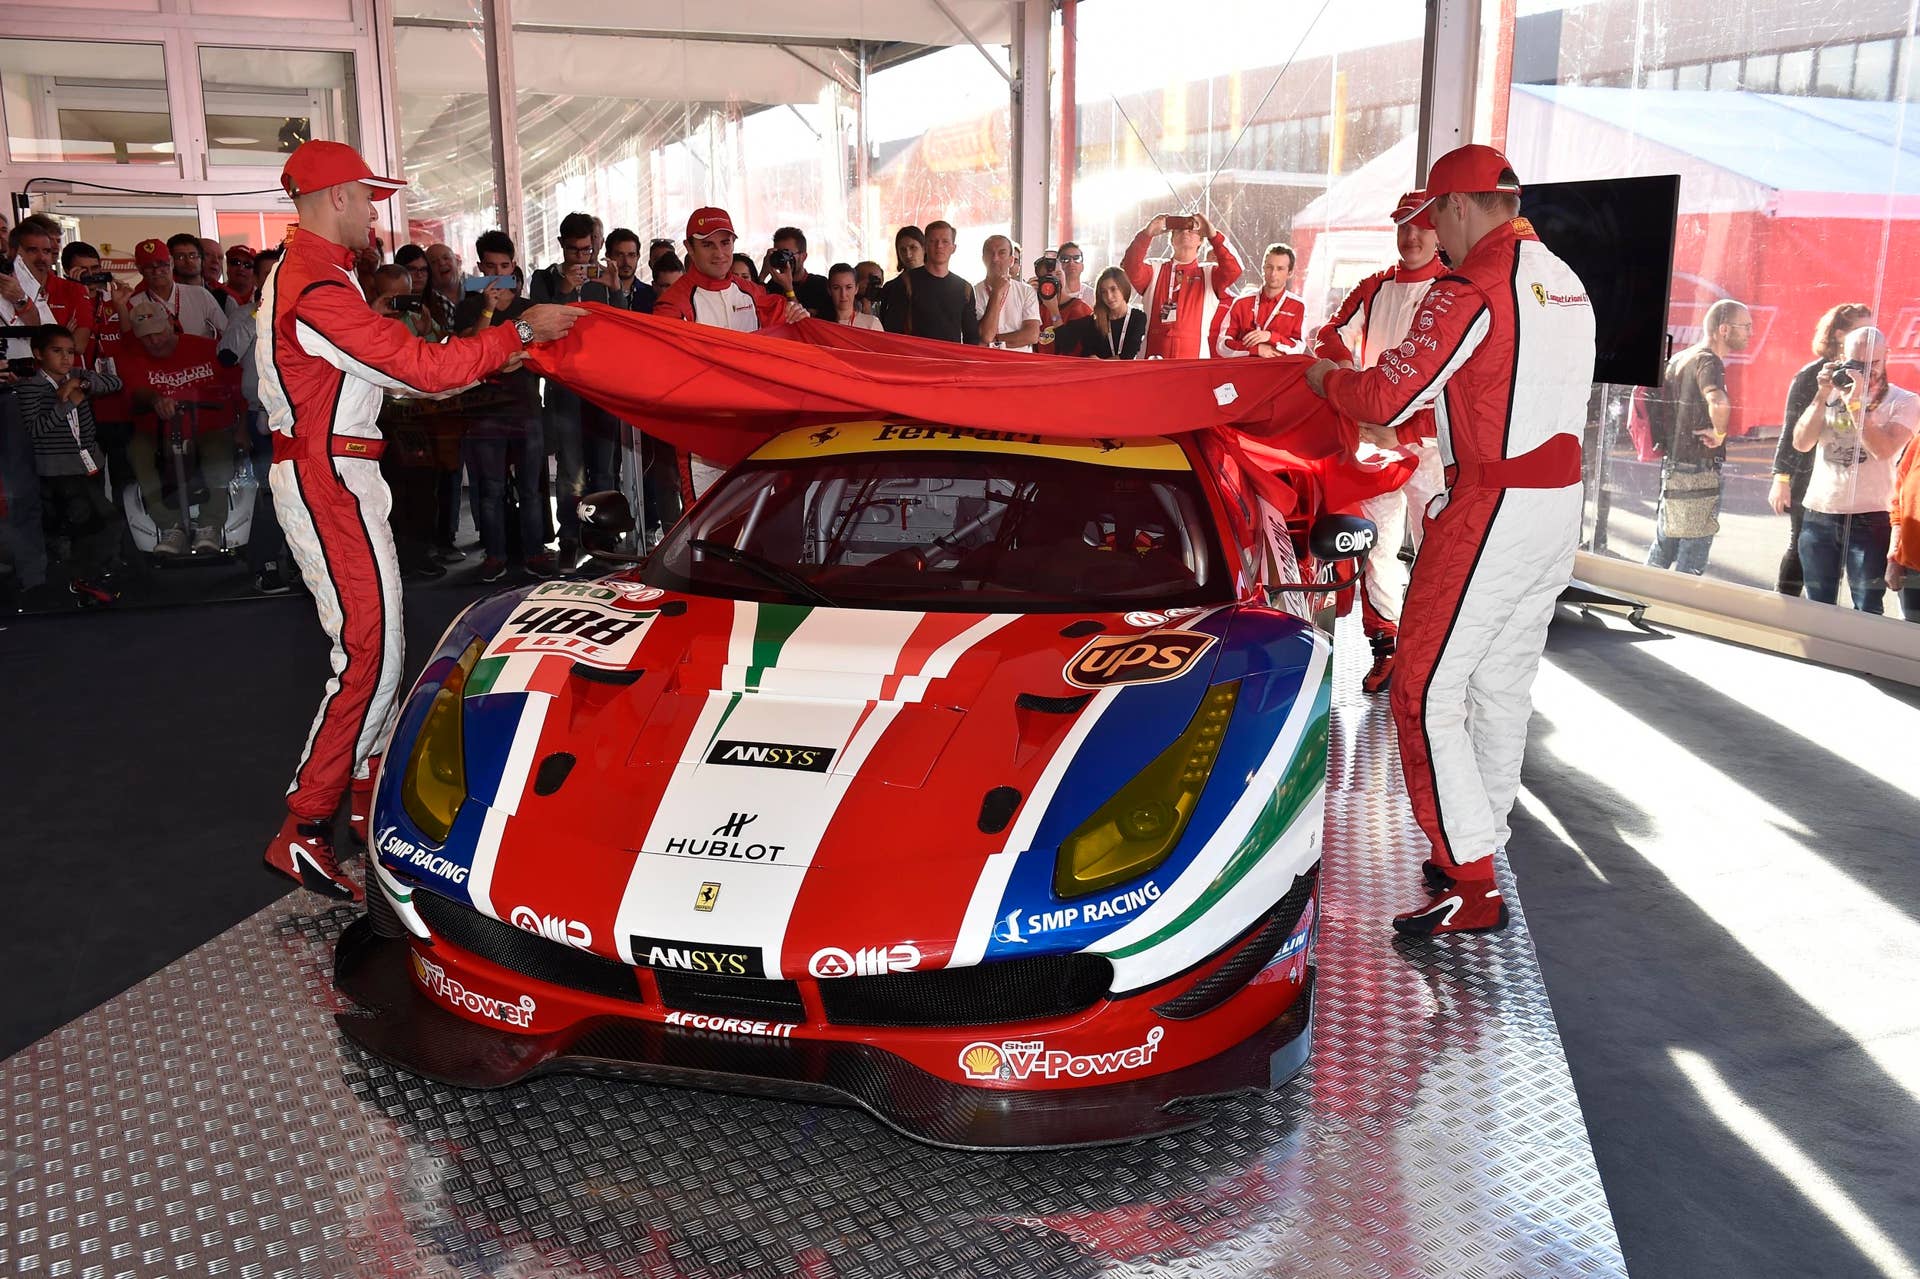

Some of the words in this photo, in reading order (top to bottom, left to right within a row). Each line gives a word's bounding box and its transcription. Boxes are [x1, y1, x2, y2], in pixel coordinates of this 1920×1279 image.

[1383, 351, 1417, 378] HUBLOT
[872, 424, 1042, 444] Ferrari
[536, 583, 617, 600] PRO
[508, 607, 644, 646] 488
[532, 636, 609, 658] GTE
[722, 745, 817, 766] ANSYS
[384, 836, 415, 860] SMP
[410, 849, 469, 884] RACING
[665, 837, 786, 862] HUBLOT
[1028, 908, 1079, 935] SMP
[1083, 880, 1162, 923] RACING
[649, 946, 747, 975] ANSYS
[429, 971, 533, 1028] V-Power
[664, 1011, 798, 1038] AFCORSE.IT
[1004, 1042, 1042, 1051] Shell
[1008, 1042, 1158, 1080] V-Power
